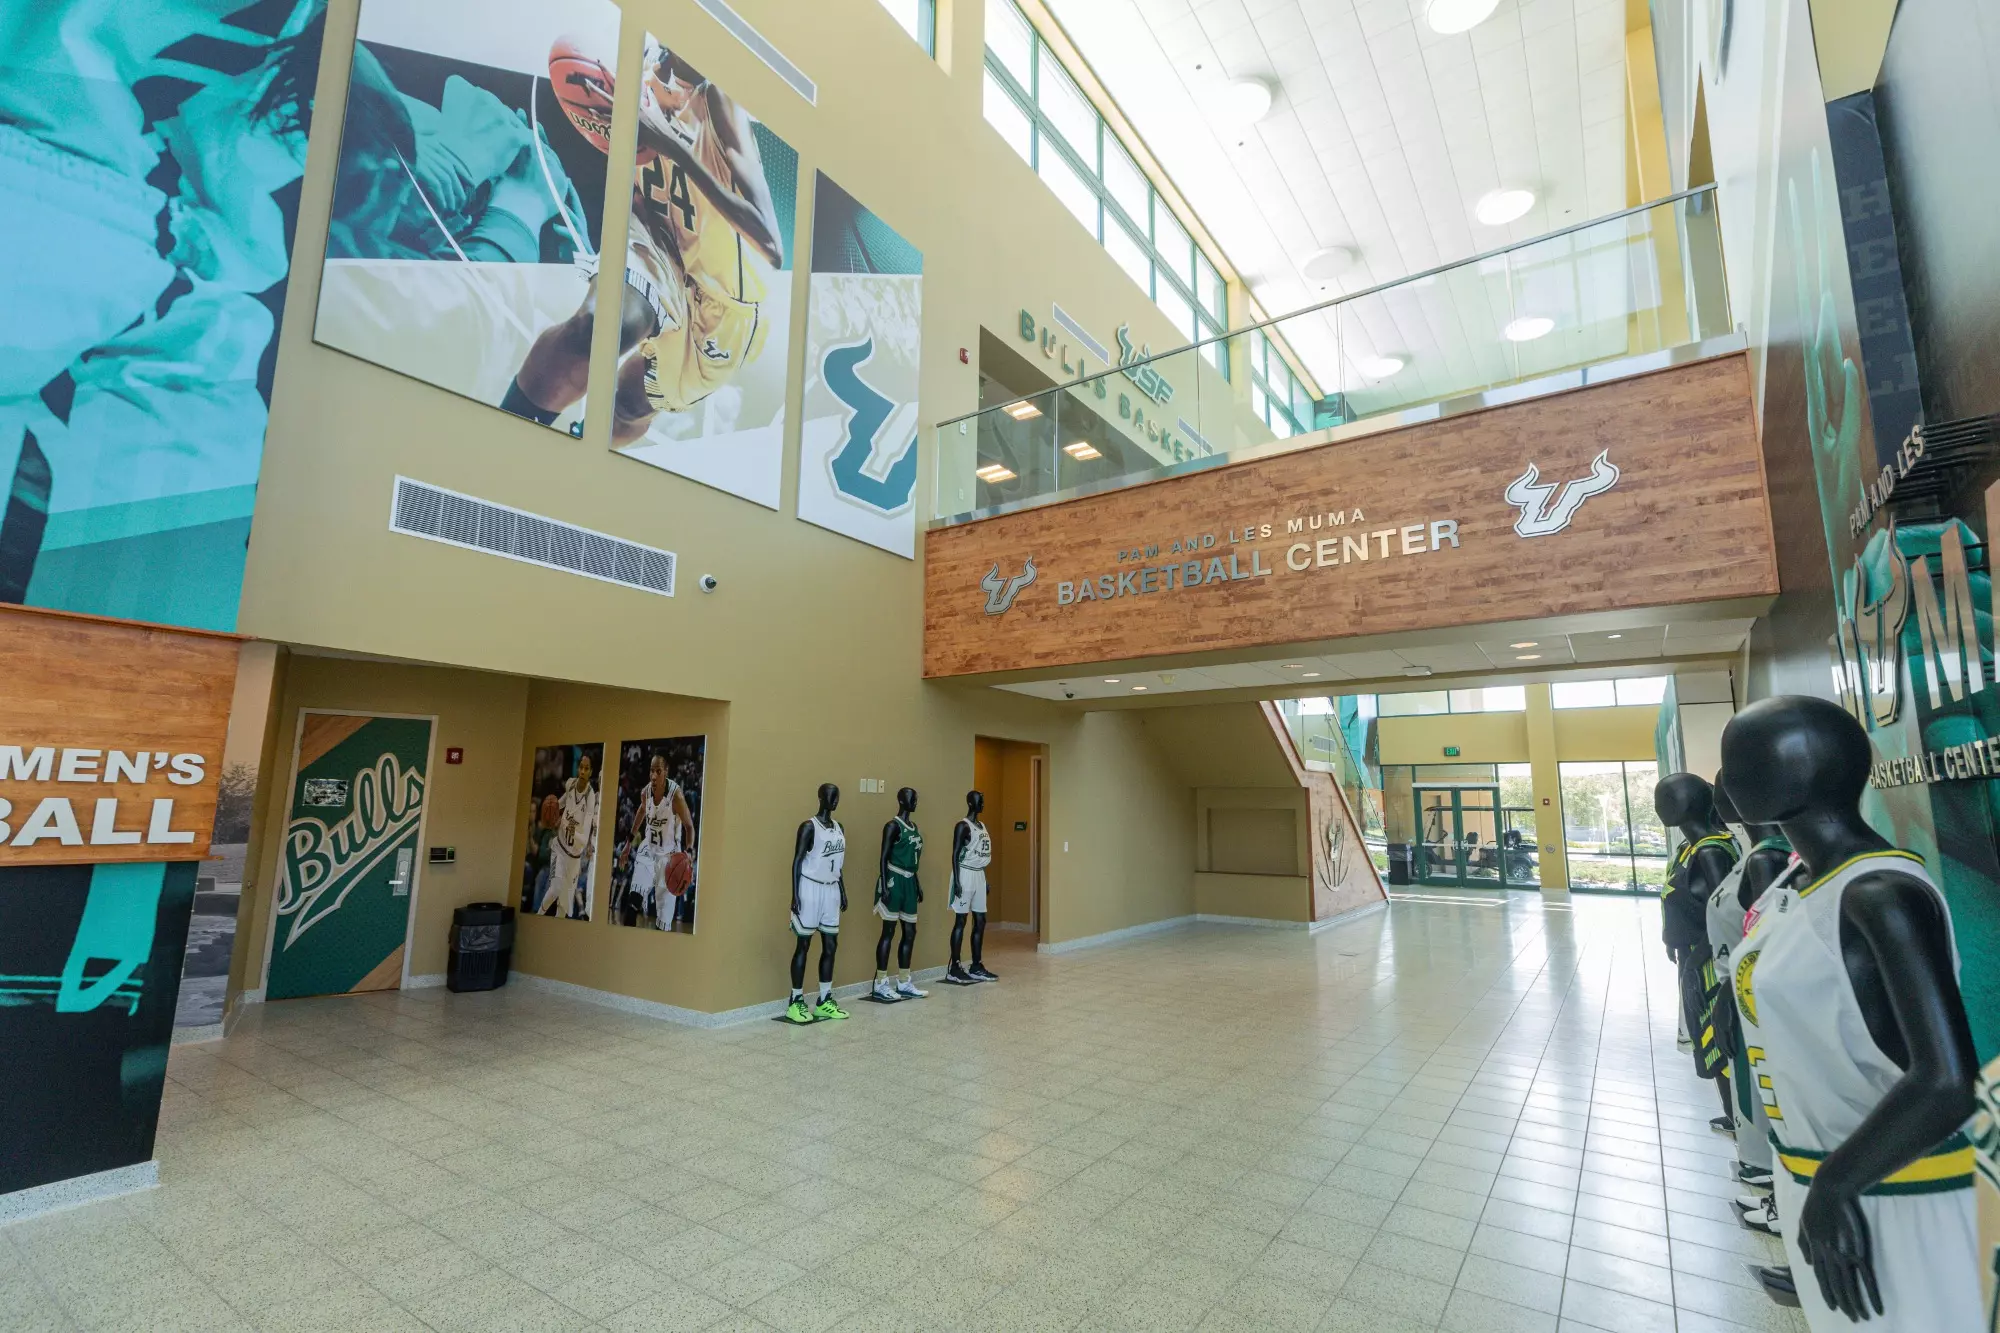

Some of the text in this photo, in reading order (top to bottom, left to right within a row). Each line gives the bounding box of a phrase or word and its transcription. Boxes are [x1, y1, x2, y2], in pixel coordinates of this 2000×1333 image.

[1021, 308, 1107, 399] BULLS
[1849, 424, 1926, 540] PAM AND LES
[1056, 518, 1461, 605] BASKETBALL CENTER
[1117, 507, 1366, 563] PAM AND LES MUMA
[1869, 751, 1941, 789] BASKETBALL
[277, 752, 425, 915] Bulls
[650, 829, 663, 847] 21
[830, 859, 835, 872] 1
